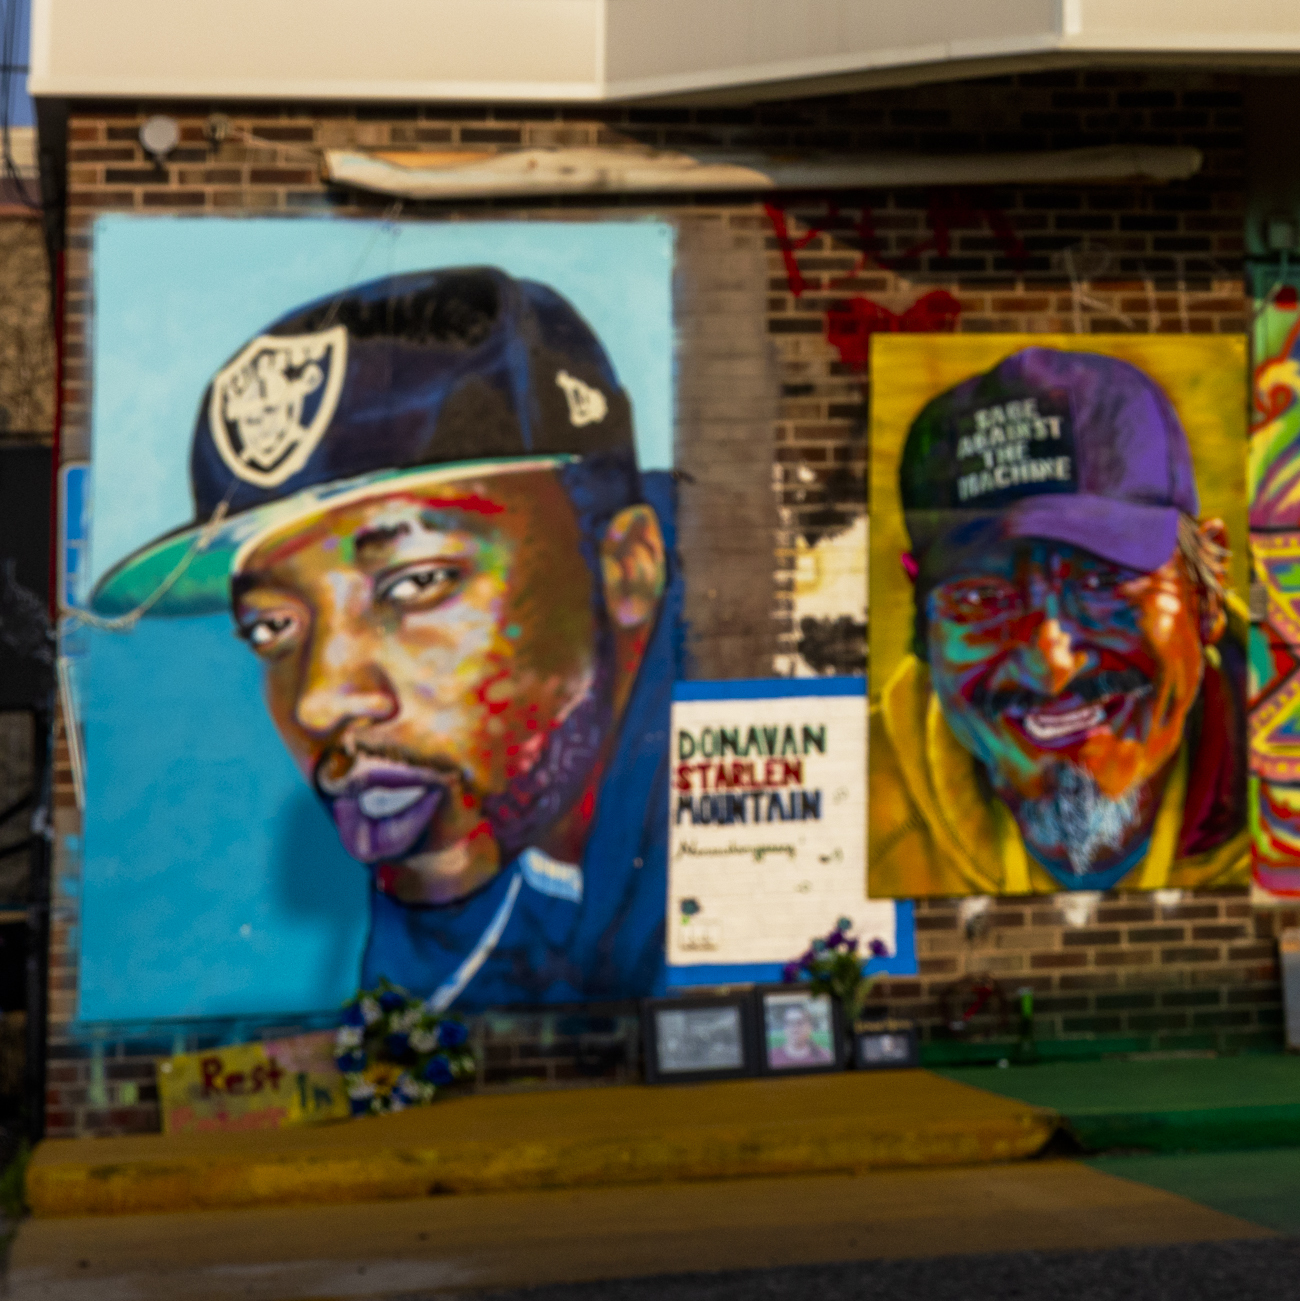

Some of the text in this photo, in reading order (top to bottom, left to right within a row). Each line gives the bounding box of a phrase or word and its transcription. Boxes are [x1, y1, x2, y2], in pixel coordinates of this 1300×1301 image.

[956, 414, 1065, 462] AGAINST
[982, 440, 1029, 469] THE
[956, 455, 1072, 503] MACHINE
[677, 722, 827, 760] DONAVAN
[676, 789, 824, 826] MOUNTAIN
[200, 1055, 285, 1100] Rest
